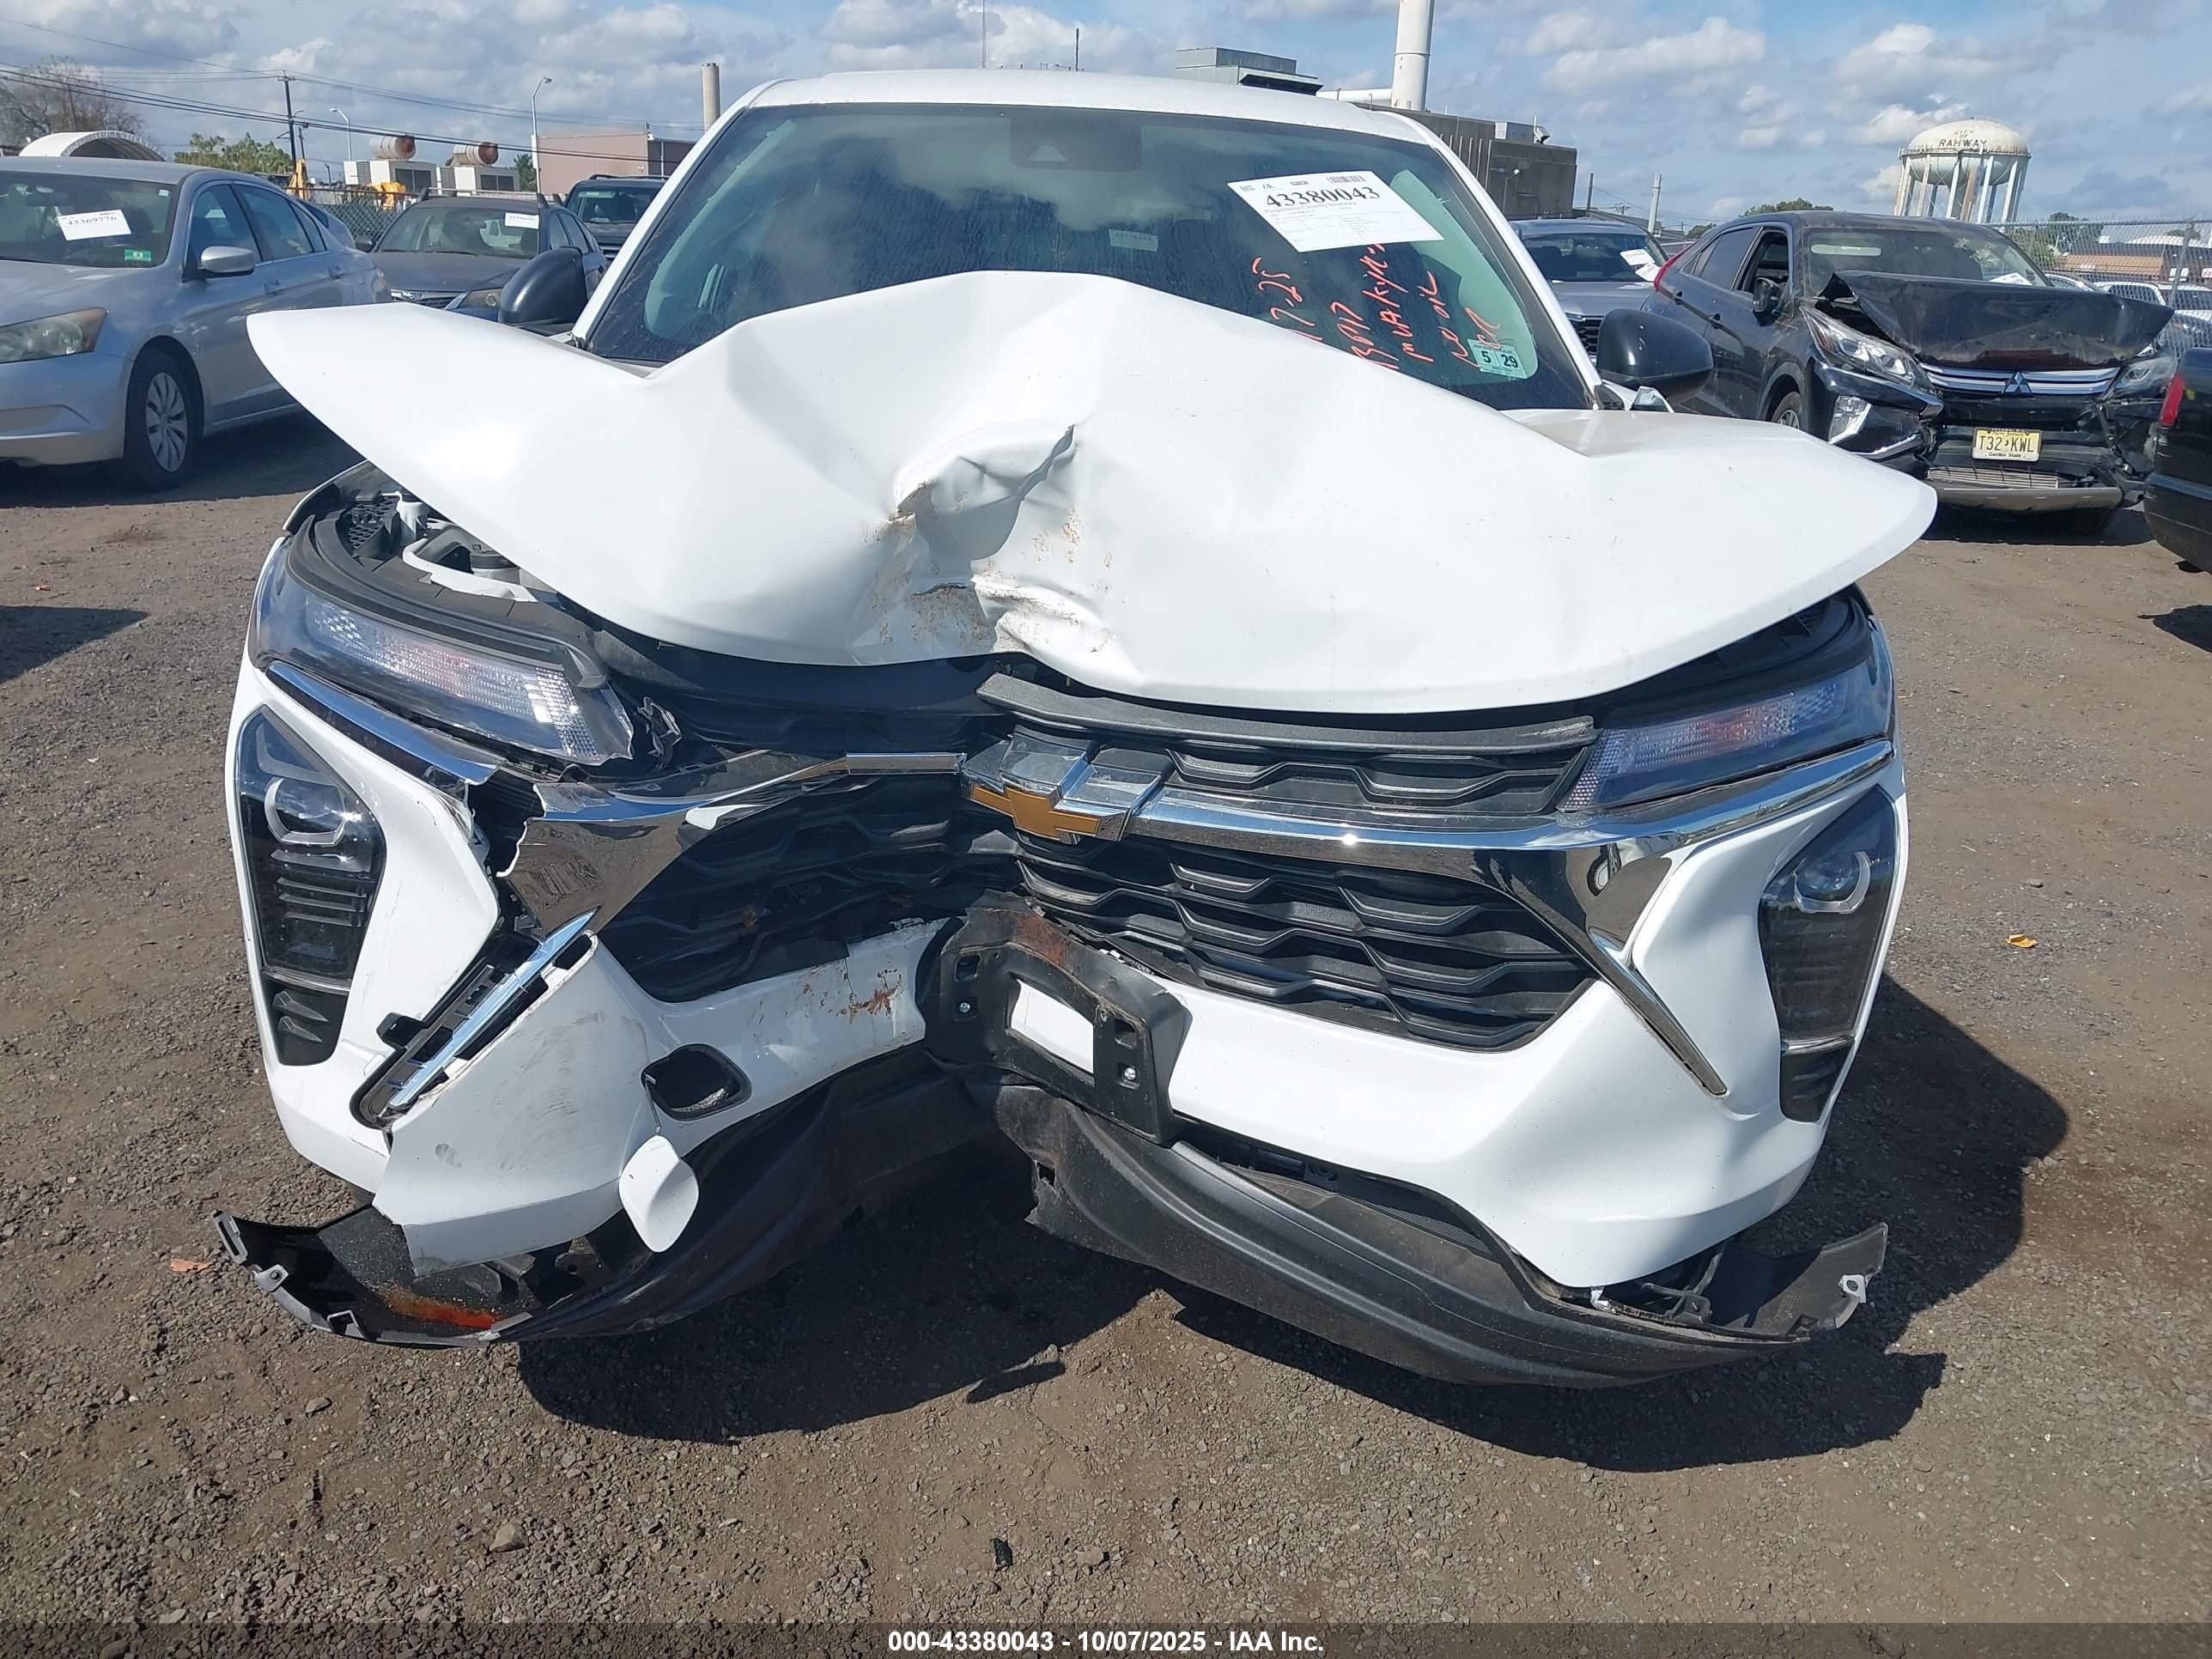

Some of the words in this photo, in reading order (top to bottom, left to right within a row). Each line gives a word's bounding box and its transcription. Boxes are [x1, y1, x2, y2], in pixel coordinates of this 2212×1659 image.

[1938, 139, 1988, 148] RAHWAY
[1267, 186, 1380, 207] 43380043
[1481, 350, 1492, 363] 5
[1501, 354, 1518, 368] 29
[1978, 435, 2002, 451] T32
[2010, 437, 2034, 453] KWL
